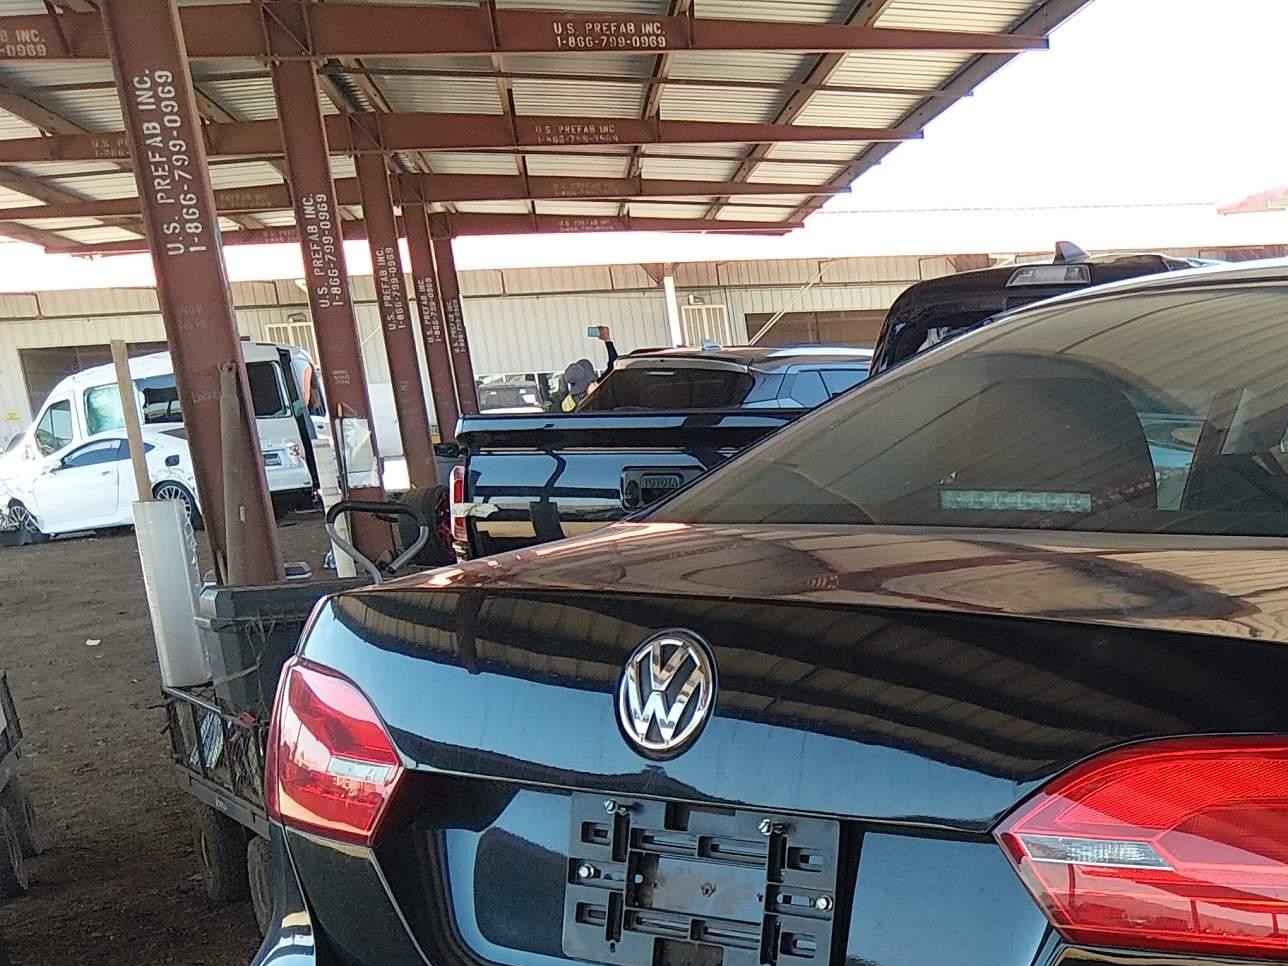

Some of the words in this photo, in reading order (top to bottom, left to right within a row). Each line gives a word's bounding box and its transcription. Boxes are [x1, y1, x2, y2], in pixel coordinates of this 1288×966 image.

[15, 29, 46, 42] INC.
[553, 22, 579, 34] U.S.
[585, 22, 635, 34] PREFAB
[641, 22, 666, 34] INC.
[556, 36, 666, 48] 1-866-799-0969
[133, 69, 156, 111] INC.
[600, 124, 615, 134] INC
[142, 121, 175, 204] PREFAB
[154, 70, 207, 253] 1-866-799-0969
[303, 193, 317, 219] INC.
[163, 215, 186, 256] U.S.
[306, 225, 326, 276] PREFAB
[315, 193, 344, 306] 1-866-799-0969
[317, 283, 331, 308] U.S.
[379, 270, 393, 307] PREFAB
[641, 477, 679, 488] TOYOTA
